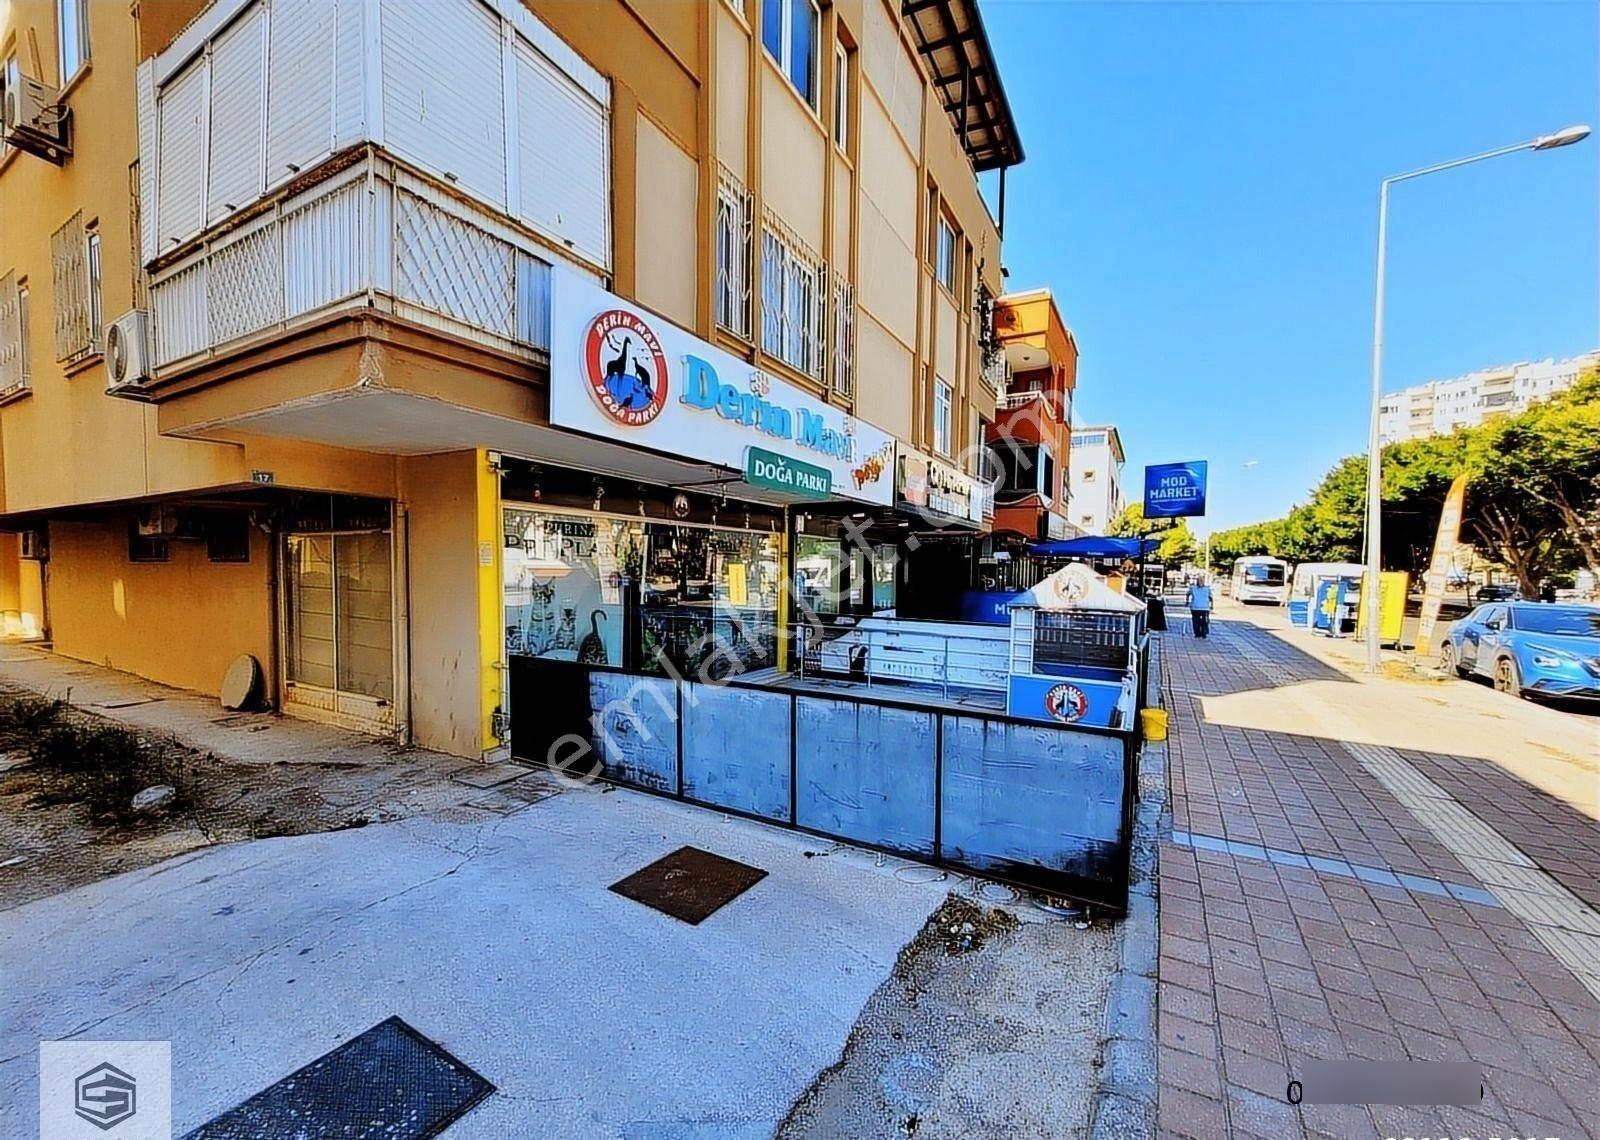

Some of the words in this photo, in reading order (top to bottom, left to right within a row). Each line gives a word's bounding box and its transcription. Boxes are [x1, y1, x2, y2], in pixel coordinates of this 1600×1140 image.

[754, 457, 794, 485] DOĞA
[796, 471, 827, 493] PARKI
[1161, 476, 1187, 488] MOD
[1149, 486, 1200, 500] MARKET
